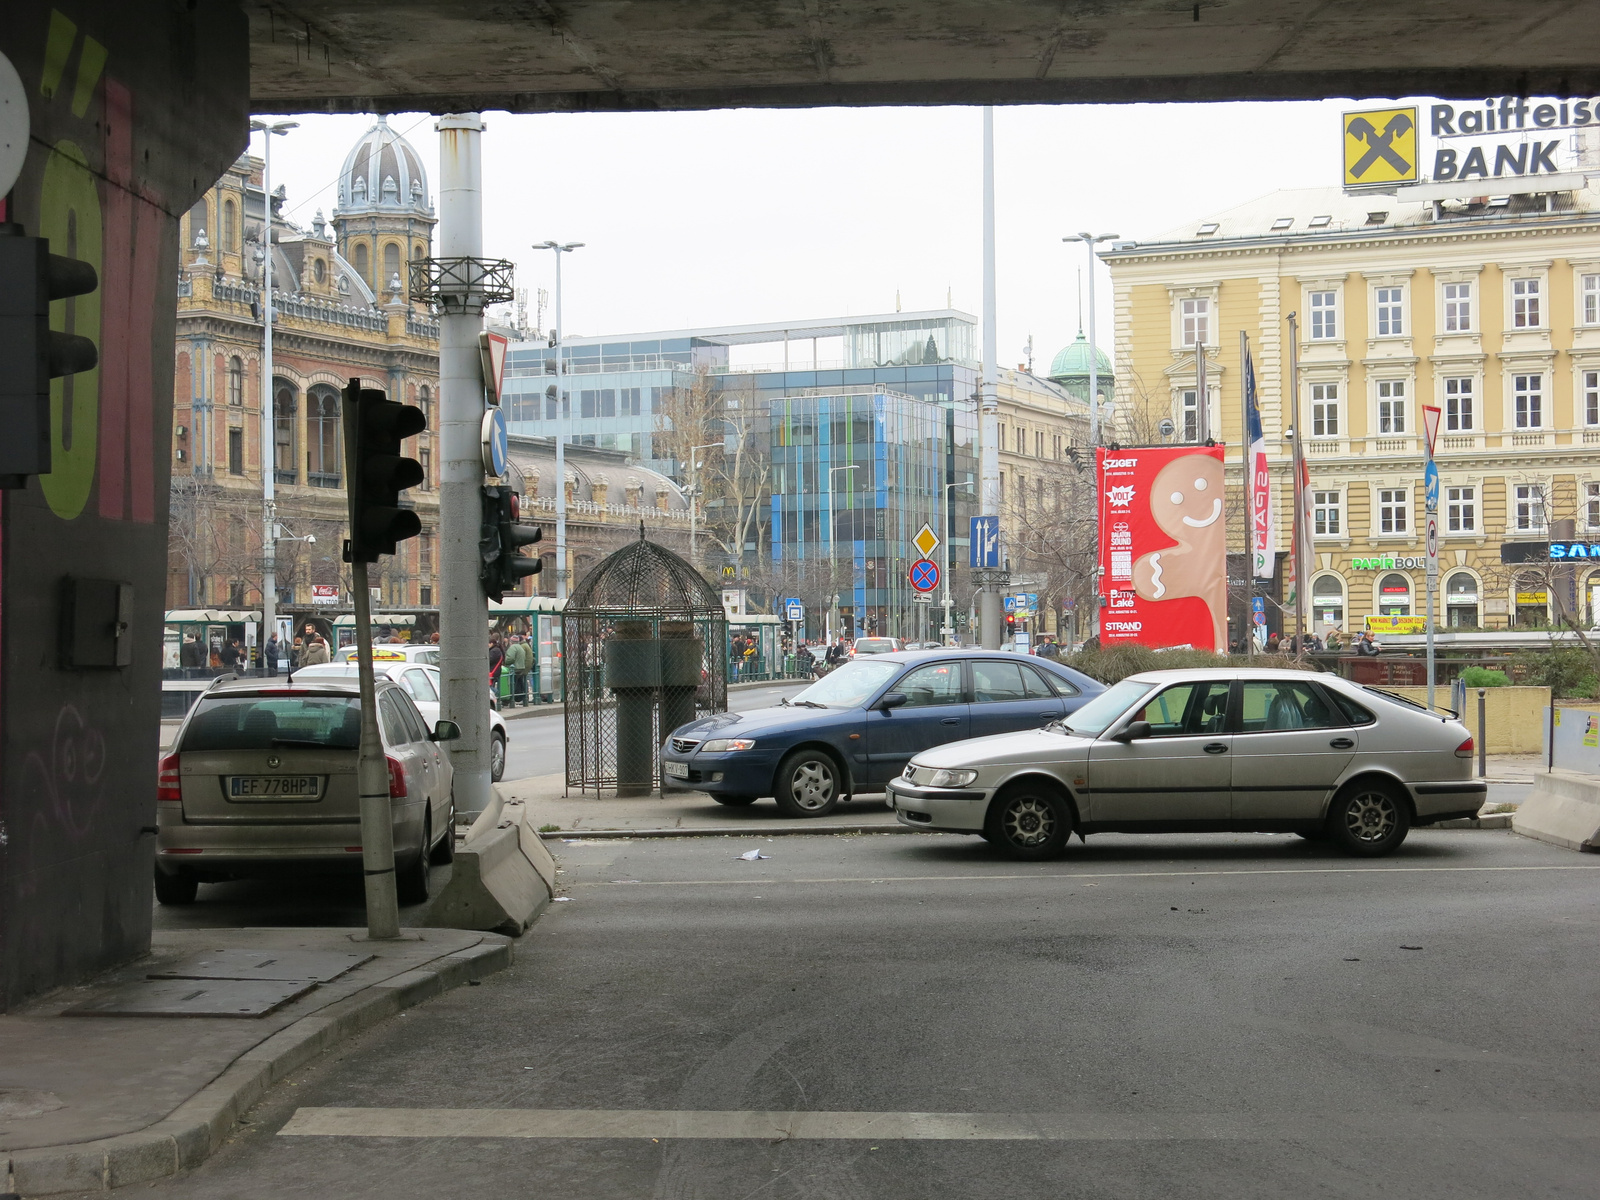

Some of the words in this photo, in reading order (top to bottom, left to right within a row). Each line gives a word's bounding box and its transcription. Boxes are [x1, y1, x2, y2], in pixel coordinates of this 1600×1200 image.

[1431, 96, 1600, 136] Raiffeis
[1433, 140, 1561, 181] BANK
[1112, 492, 1130, 500] VOLT
[1111, 537, 1131, 545] SOUND
[1110, 598, 1135, 607] Lake
[1105, 622, 1142, 630] STRAND
[242, 780, 258, 793] EF
[264, 779, 307, 793] 778HP
